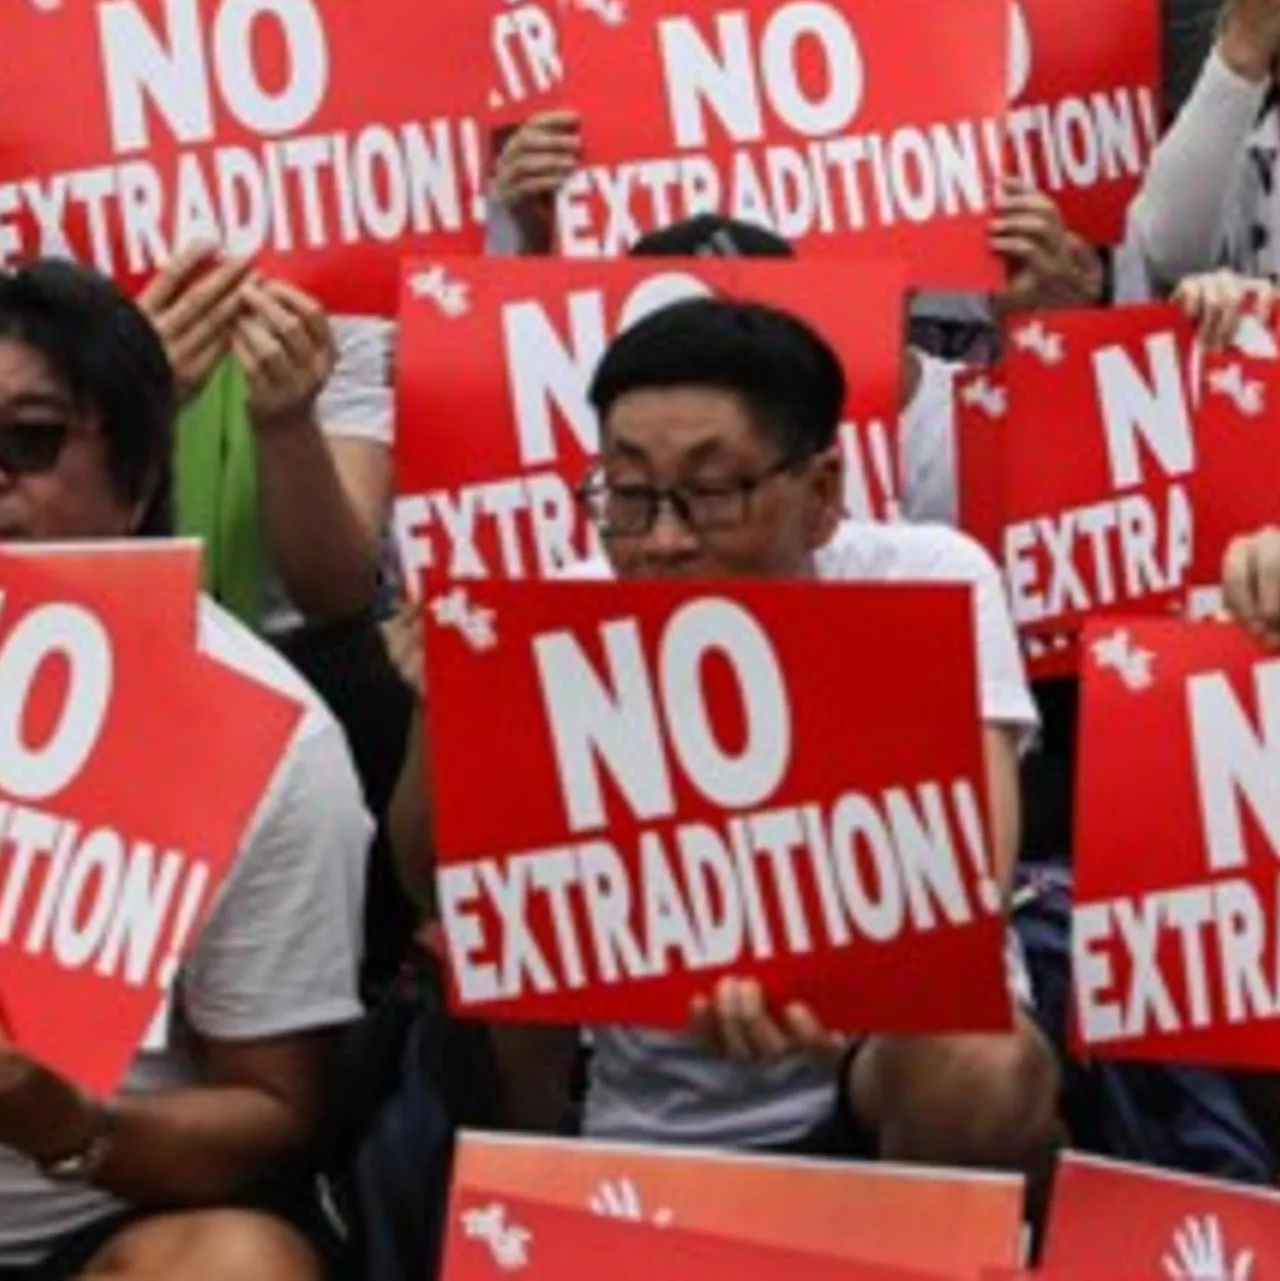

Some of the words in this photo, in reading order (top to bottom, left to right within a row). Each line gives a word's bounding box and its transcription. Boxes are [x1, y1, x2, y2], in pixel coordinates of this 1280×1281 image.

[557, 118, 1007, 259] EXTRADITION!
[1092, 329, 1200, 490] N
[531, 595, 793, 833] NO
[436, 778, 1002, 1007] EXTRADITION!
